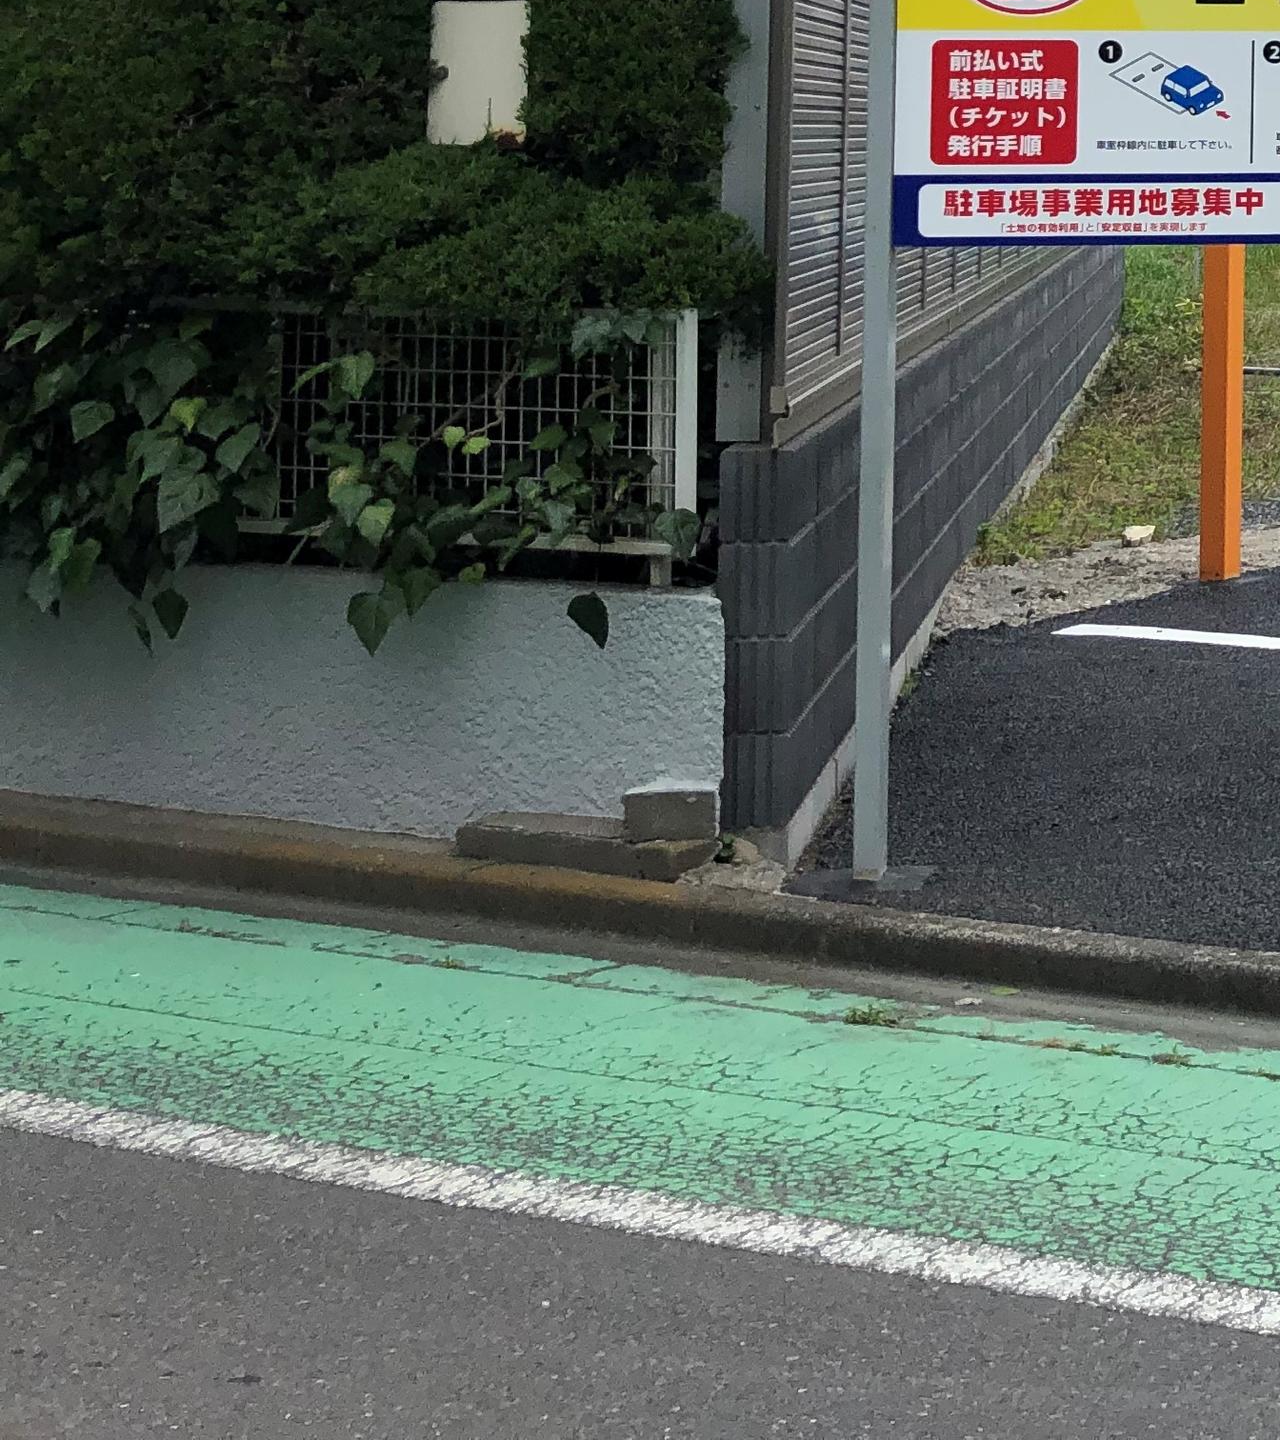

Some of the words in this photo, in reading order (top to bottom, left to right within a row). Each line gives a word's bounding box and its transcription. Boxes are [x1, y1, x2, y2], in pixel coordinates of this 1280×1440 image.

[949, 49, 1043, 72] 前払い式
[948, 78, 1067, 100] 駐車証明書
[947, 134, 1042, 157] 発行手順
[1096, 140, 1234, 151] 車室枠線内に駐車して下さい。
[943, 188, 1264, 217] 駐車場事業用地募集中
